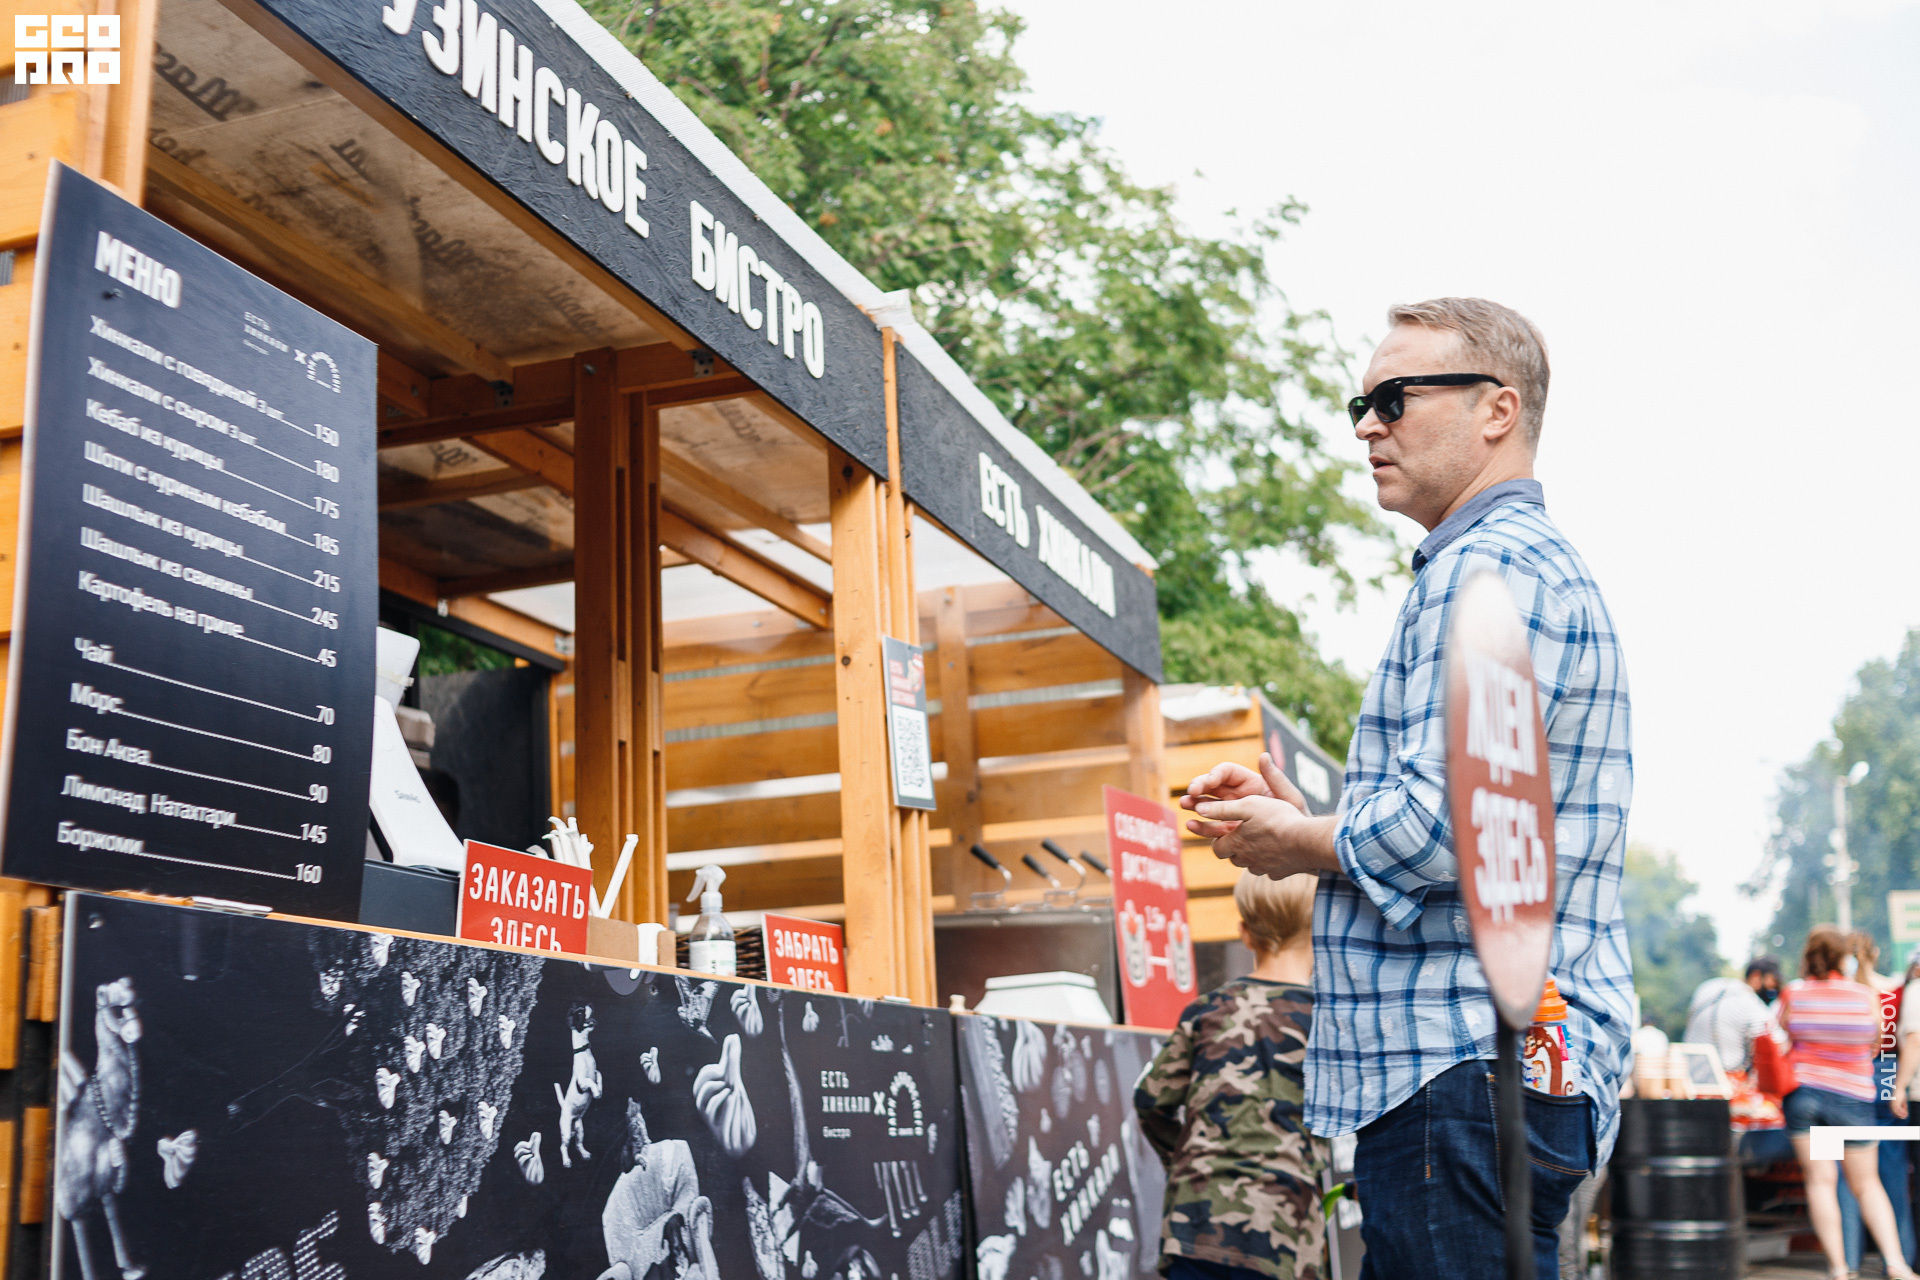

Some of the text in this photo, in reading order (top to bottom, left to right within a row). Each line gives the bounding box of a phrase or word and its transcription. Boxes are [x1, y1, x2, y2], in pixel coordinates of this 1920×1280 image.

[95, 230, 182, 309] МЕНЮ
[690, 200, 824, 379] БИСТРО
[87, 356, 162, 405] Хинкали
[174, 399, 230, 434] сыром
[229, 424, 239, 439] 3
[313, 460, 340, 483] 180
[90, 315, 163, 365] Хинкали
[176, 359, 257, 409] говядиной
[257, 399, 267, 413] 3
[313, 423, 340, 447] 150
[84, 440, 133, 474] Шоти
[147, 470, 221, 511] куриным
[222, 499, 287, 534] кебабом
[313, 533, 340, 556] 185
[86, 398, 340, 519] Кебаб из курицы 175
[978, 451, 1030, 549] ЕСТЬ
[80, 526, 339, 630] Шашлык из свинины 245
[82, 483, 341, 593] Шашлык из курицы 215
[78, 570, 337, 668] Картофель на гриле 45
[70, 682, 332, 765] Морс 80
[74, 637, 335, 726] Чай 70
[60, 774, 328, 844] Лимонад Натахтари 145
[66, 728, 329, 804] Бон Аква 90
[57, 820, 322, 884] Боржоми 160
[469, 863, 585, 920] ЗАКАЗАТЬ
[1471, 786, 1548, 924] ЗДЕСЬ
[773, 928, 839, 965] ЗАБРАТЬ
[821, 1070, 850, 1089] ЕСТЬ
[822, 1095, 871, 1113] ХИНКАЛИ
[1053, 1140, 1090, 1202] ЕСТЬ
